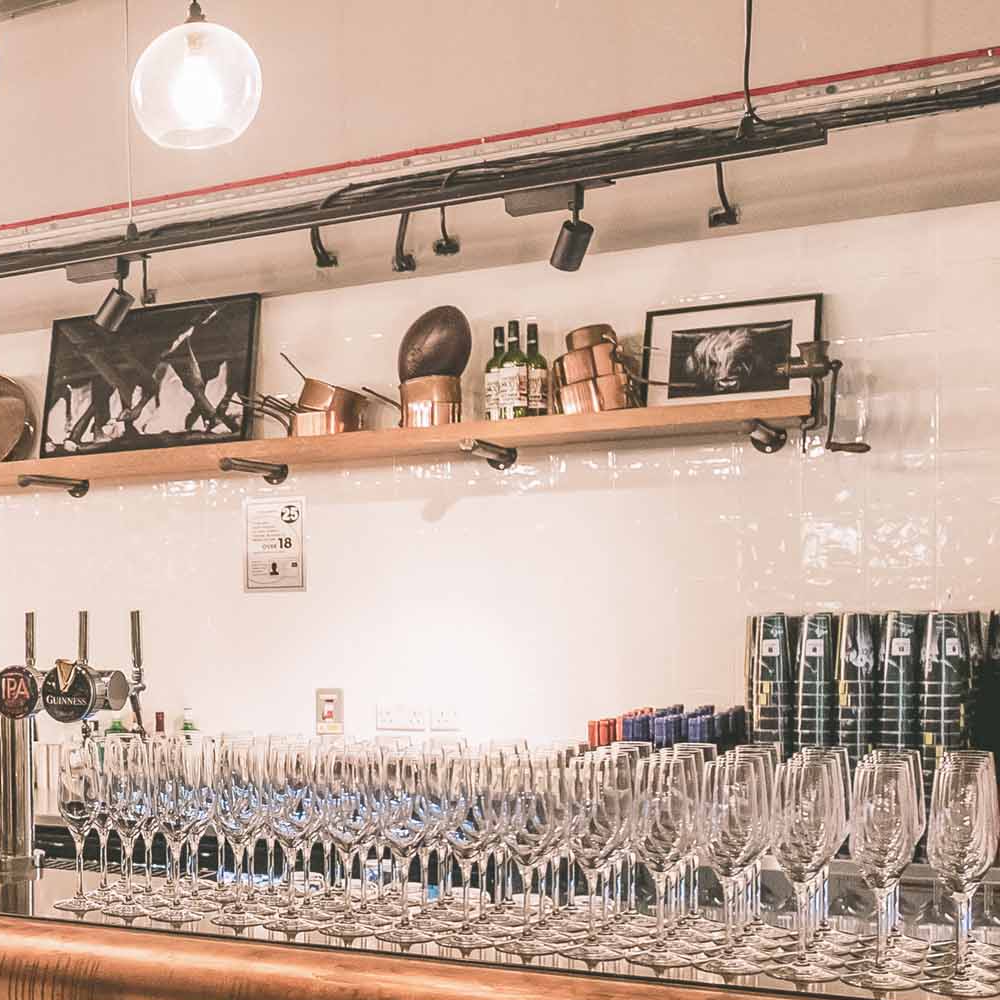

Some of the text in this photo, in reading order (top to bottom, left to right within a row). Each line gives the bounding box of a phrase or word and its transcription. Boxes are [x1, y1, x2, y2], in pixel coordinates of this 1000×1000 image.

[278, 537, 292, 549] 18
[2, 678, 30, 699] IPA
[46, 695, 87, 705] GUINNESS
